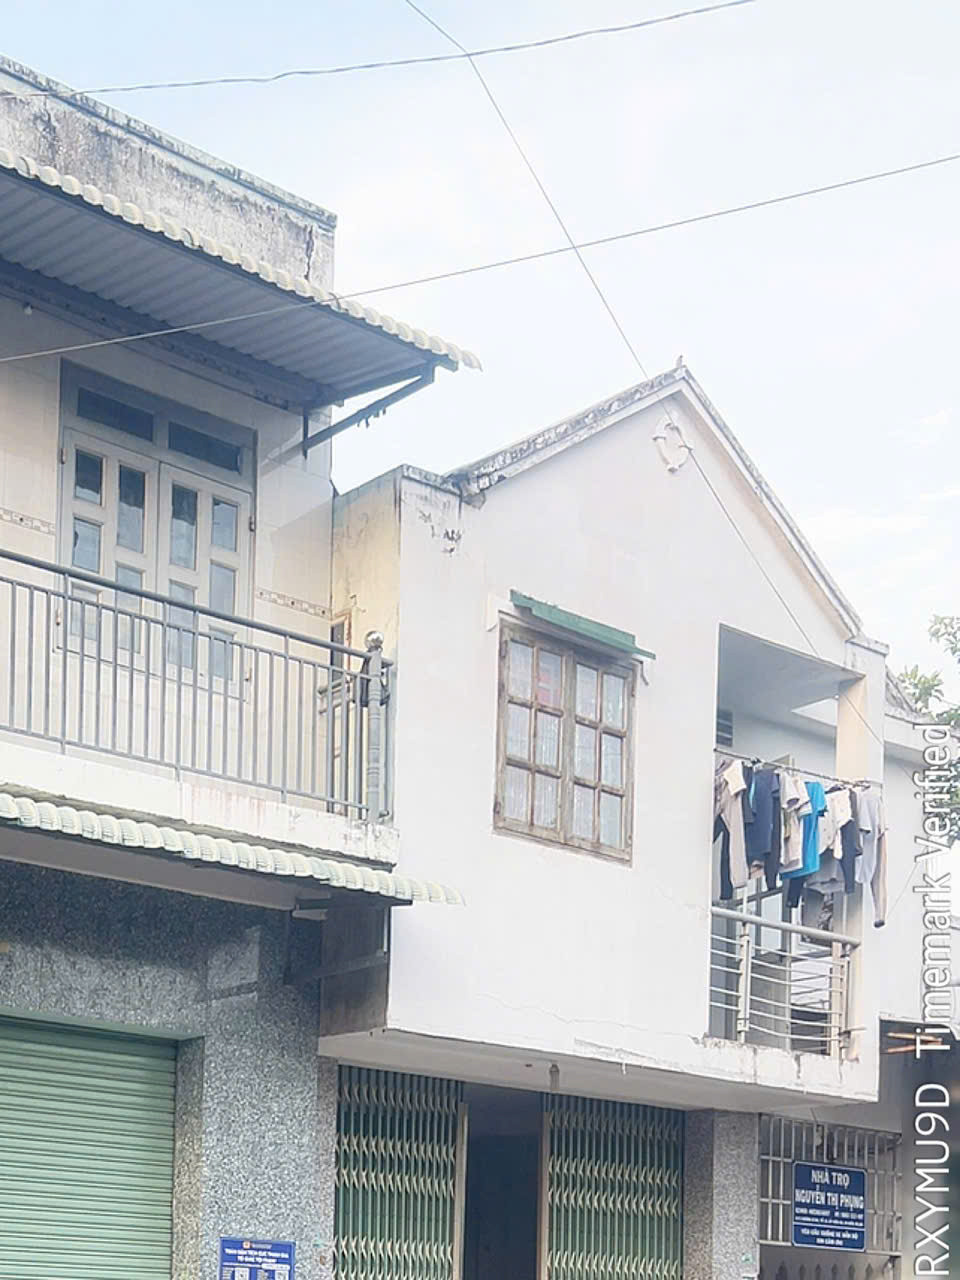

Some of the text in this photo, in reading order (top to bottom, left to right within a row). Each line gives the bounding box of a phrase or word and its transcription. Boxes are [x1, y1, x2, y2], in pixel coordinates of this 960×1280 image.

[811, 1168, 851, 1189] NHÀ TRỌ
[827, 1192, 838, 1210] THỊ
[839, 1194, 864, 1211] PHỤNG
